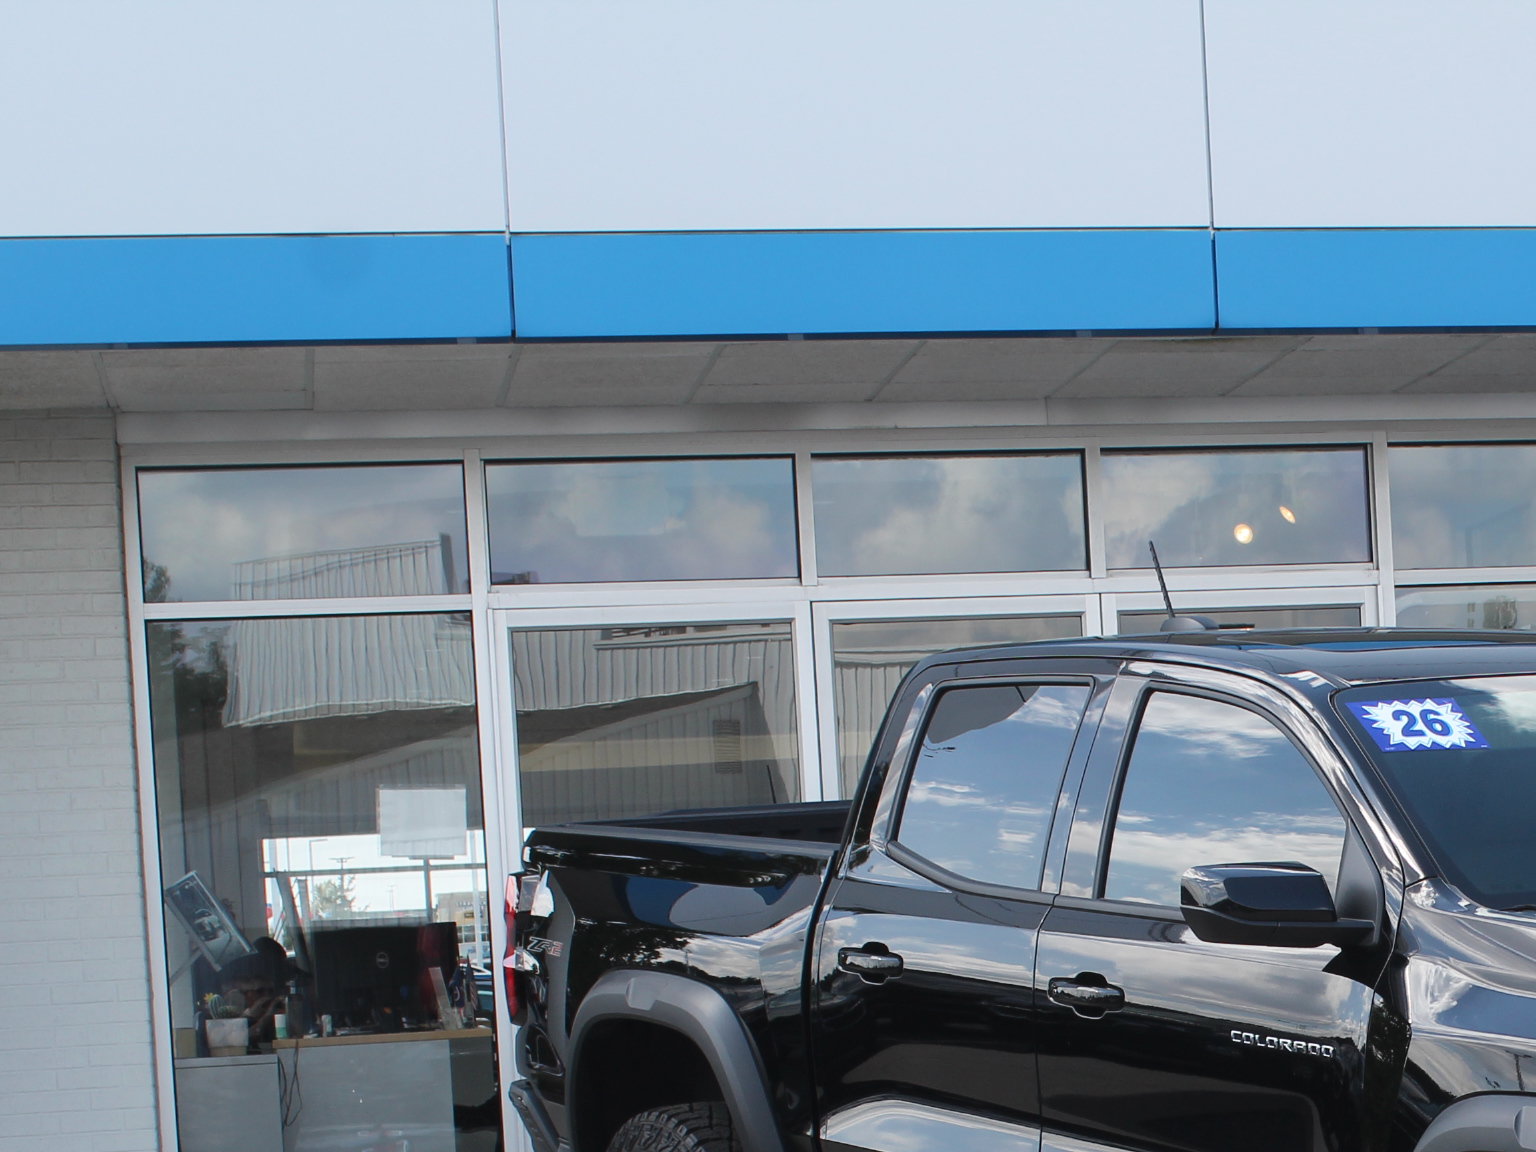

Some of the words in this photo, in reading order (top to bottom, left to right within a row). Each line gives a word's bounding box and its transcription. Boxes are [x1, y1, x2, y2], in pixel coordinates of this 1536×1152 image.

[1391, 708, 1452, 737] 26
[527, 936, 564, 958] ZR2
[1230, 1030, 1335, 1058] COLORADO
